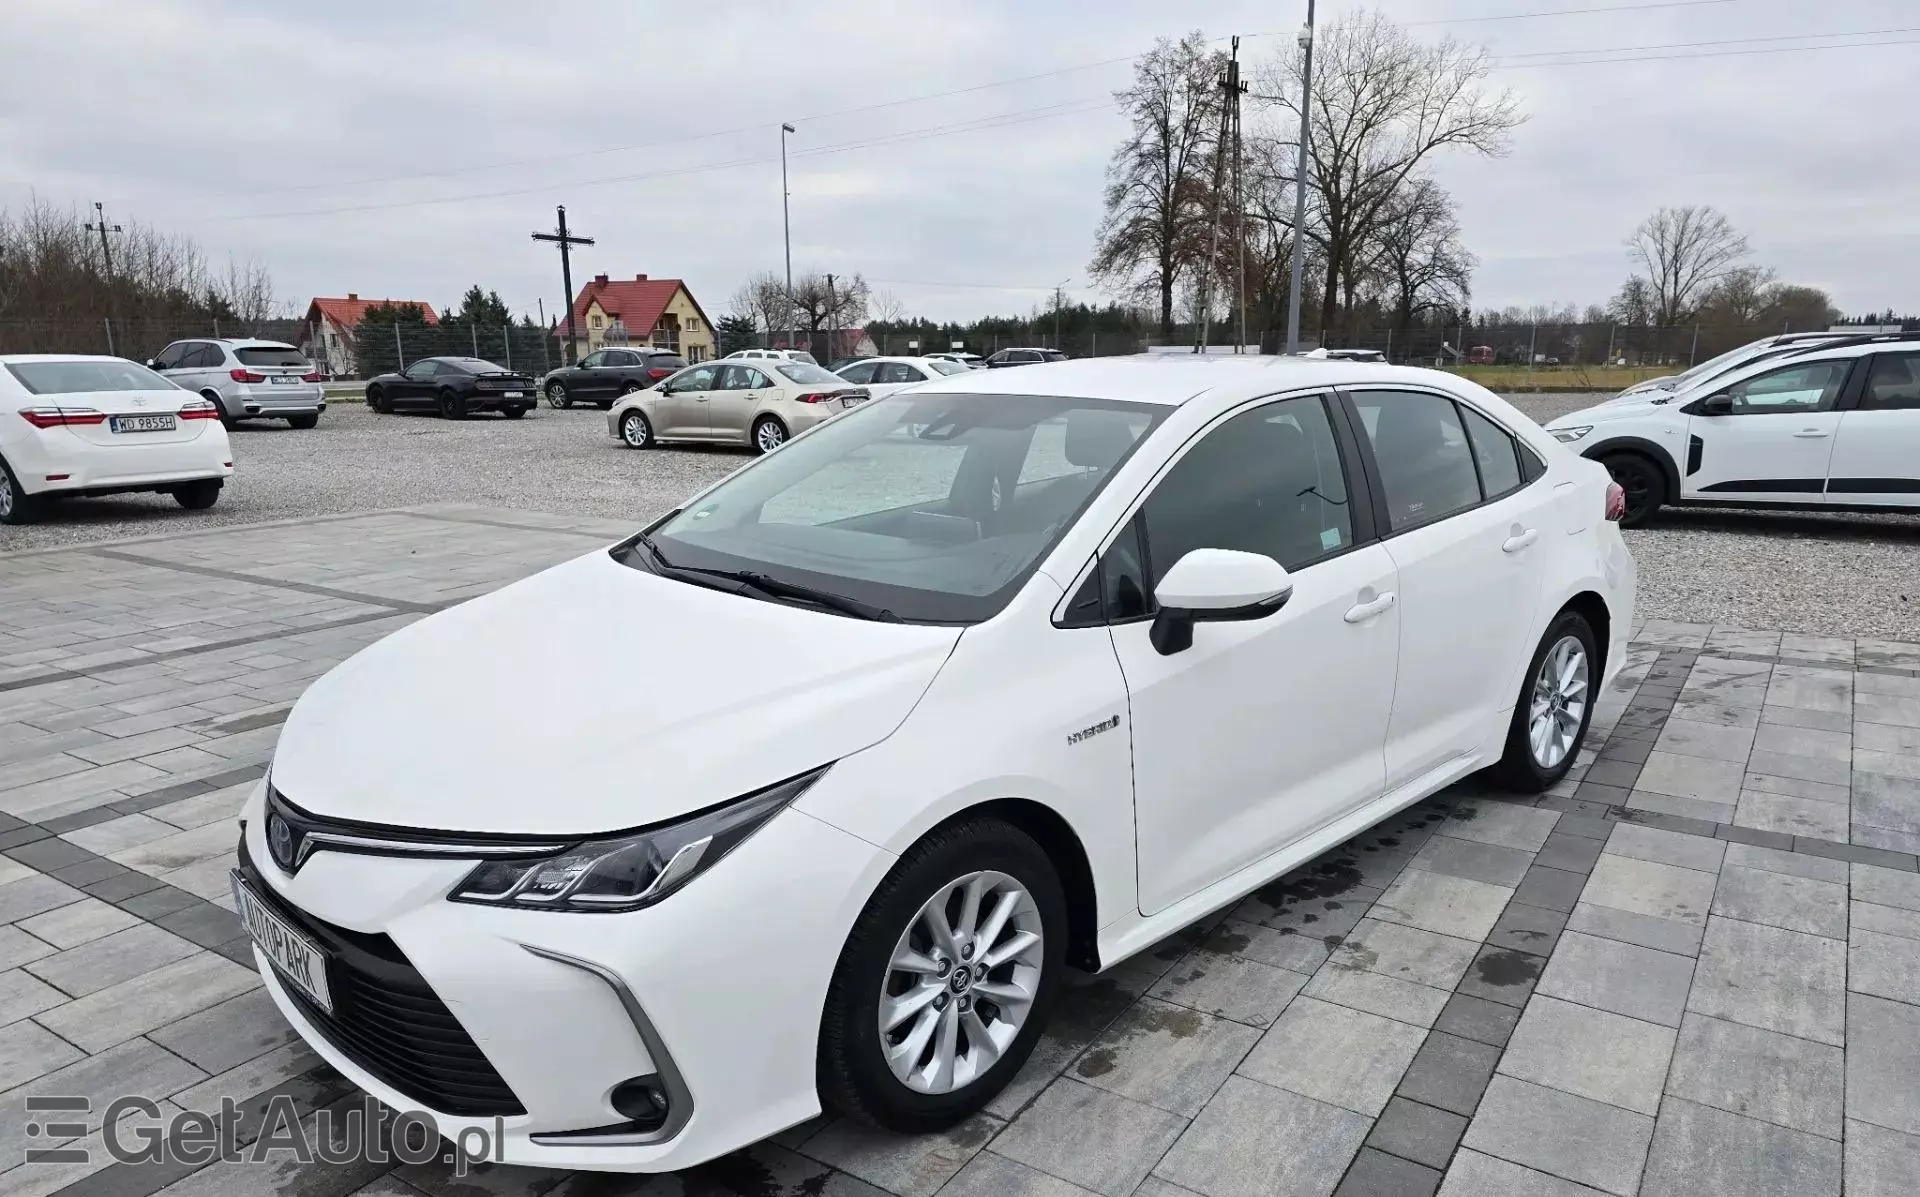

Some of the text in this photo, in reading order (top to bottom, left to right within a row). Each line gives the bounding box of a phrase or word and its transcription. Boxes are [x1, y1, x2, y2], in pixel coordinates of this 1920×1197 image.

[119, 417, 173, 431] WD 9855H
[1066, 719, 1114, 746] HYBRID
